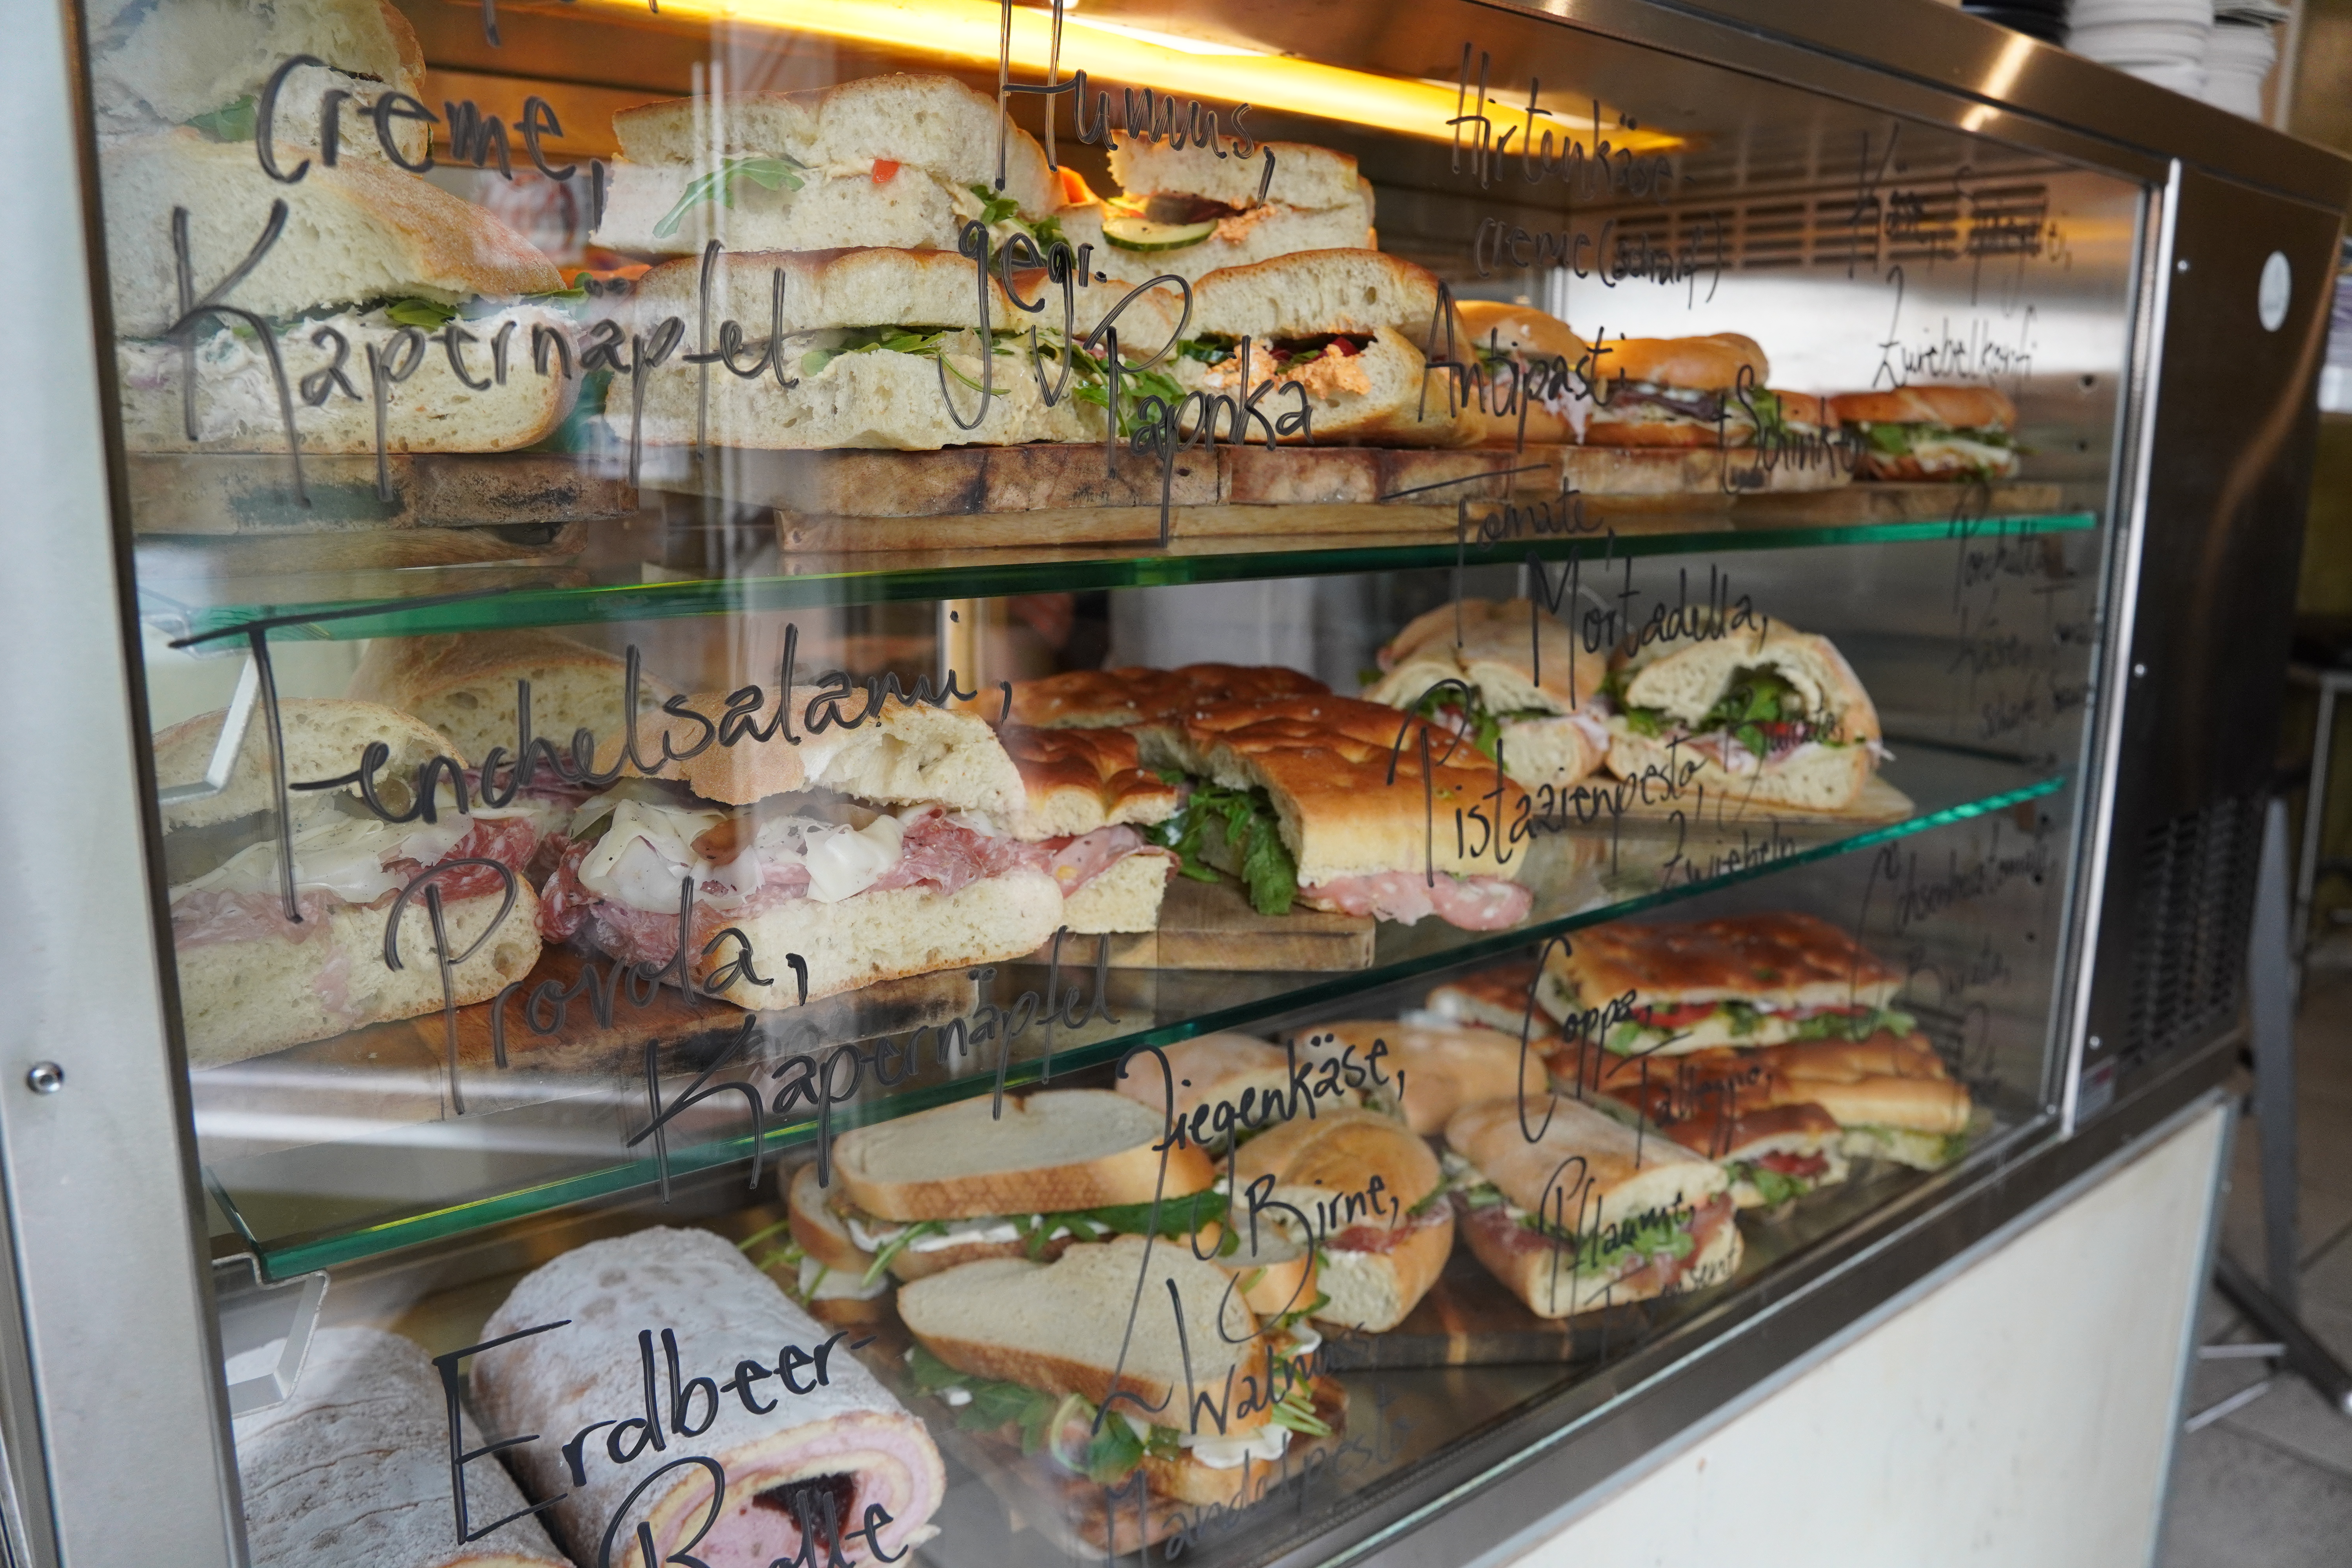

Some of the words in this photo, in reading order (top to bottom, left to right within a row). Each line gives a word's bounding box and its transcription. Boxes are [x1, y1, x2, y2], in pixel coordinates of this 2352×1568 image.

[257, 54, 604, 232] Creme,
[169, 588, 1013, 924] Fenchelsalami,
[385, 858, 808, 1115] Provola,
[1218, 1173, 1399, 1343] Birne,
[432, 1316, 878, 1546] Erdbeer-
